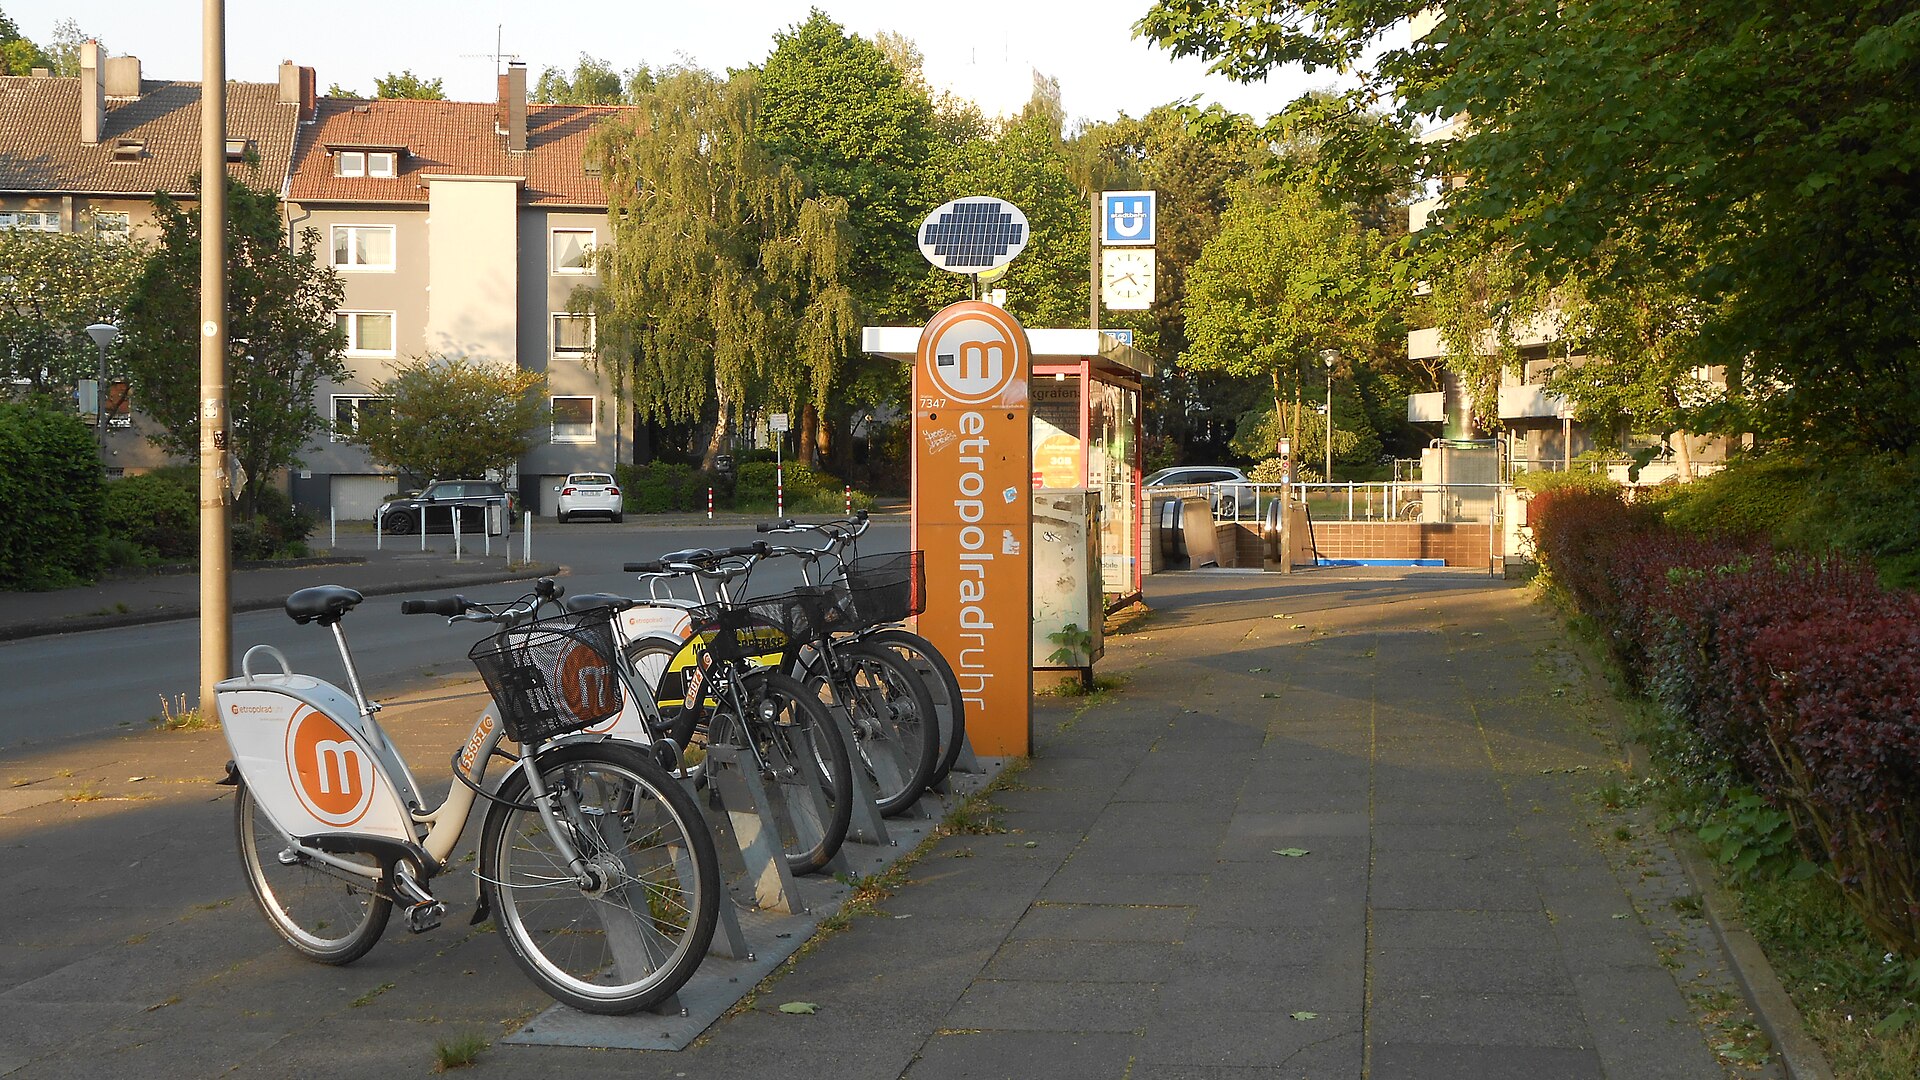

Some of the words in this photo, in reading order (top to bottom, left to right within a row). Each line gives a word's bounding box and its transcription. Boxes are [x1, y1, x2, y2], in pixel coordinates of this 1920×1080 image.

[1114, 201, 1143, 237] U
[920, 398, 947, 409] 7347
[462, 727, 487, 769] 53551
